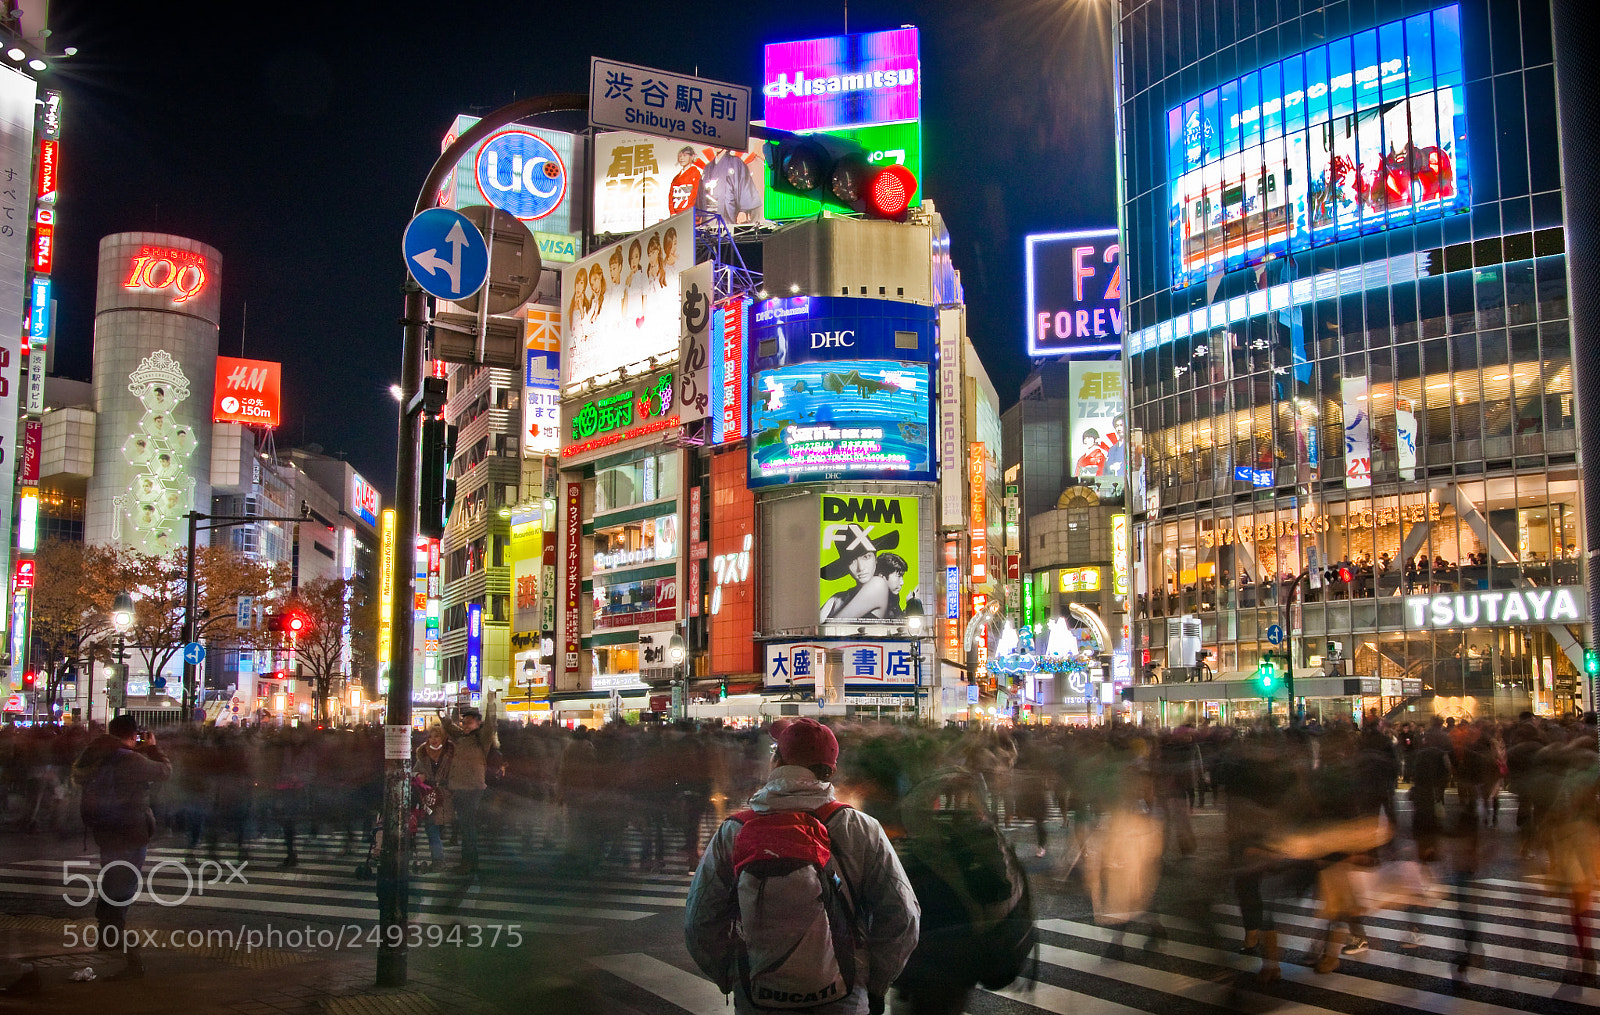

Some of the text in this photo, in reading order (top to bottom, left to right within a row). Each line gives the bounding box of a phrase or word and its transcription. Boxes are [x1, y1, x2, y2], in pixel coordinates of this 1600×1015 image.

[605, 70, 738, 122] 渋谷駅前
[763, 69, 914, 99] Hisamitsu
[625, 107, 721, 138] Shibuya Sta.
[1, 167, 18, 238] すべての
[38, 236, 50, 266] ガスト
[143, 247, 204, 265] SHIBUYA
[539, 240, 574, 256] VISA
[123, 256, 206, 302] 109
[774, 304, 810, 319] Channel
[527, 312, 561, 351] 本
[810, 330, 855, 349] DHC
[682, 282, 710, 416] もんじゃ
[30, 355, 42, 409] 渋谷駅前ビル
[227, 366, 268, 393] H&M
[722, 308, 737, 434] 三千里薬品
[241, 398, 263, 407] この先
[241, 406, 271, 418] 150m
[598, 401, 632, 432] 西村
[943, 334, 957, 470] Taisei neon
[825, 472, 842, 480] DHC
[972, 446, 984, 523] クスリのことなら
[823, 496, 903, 524] DMM
[822, 524, 877, 552] FX
[1204, 514, 1330, 549] STARBUCKS
[568, 505, 577, 600] ウィンターフルーツギフト
[517, 573, 538, 609] 薬
[657, 582, 676, 603] JTB
[1408, 589, 1579, 626] TSUTAYA
[772, 649, 911, 678] 大盛書店
[757, 980, 838, 1002] DUCATI
